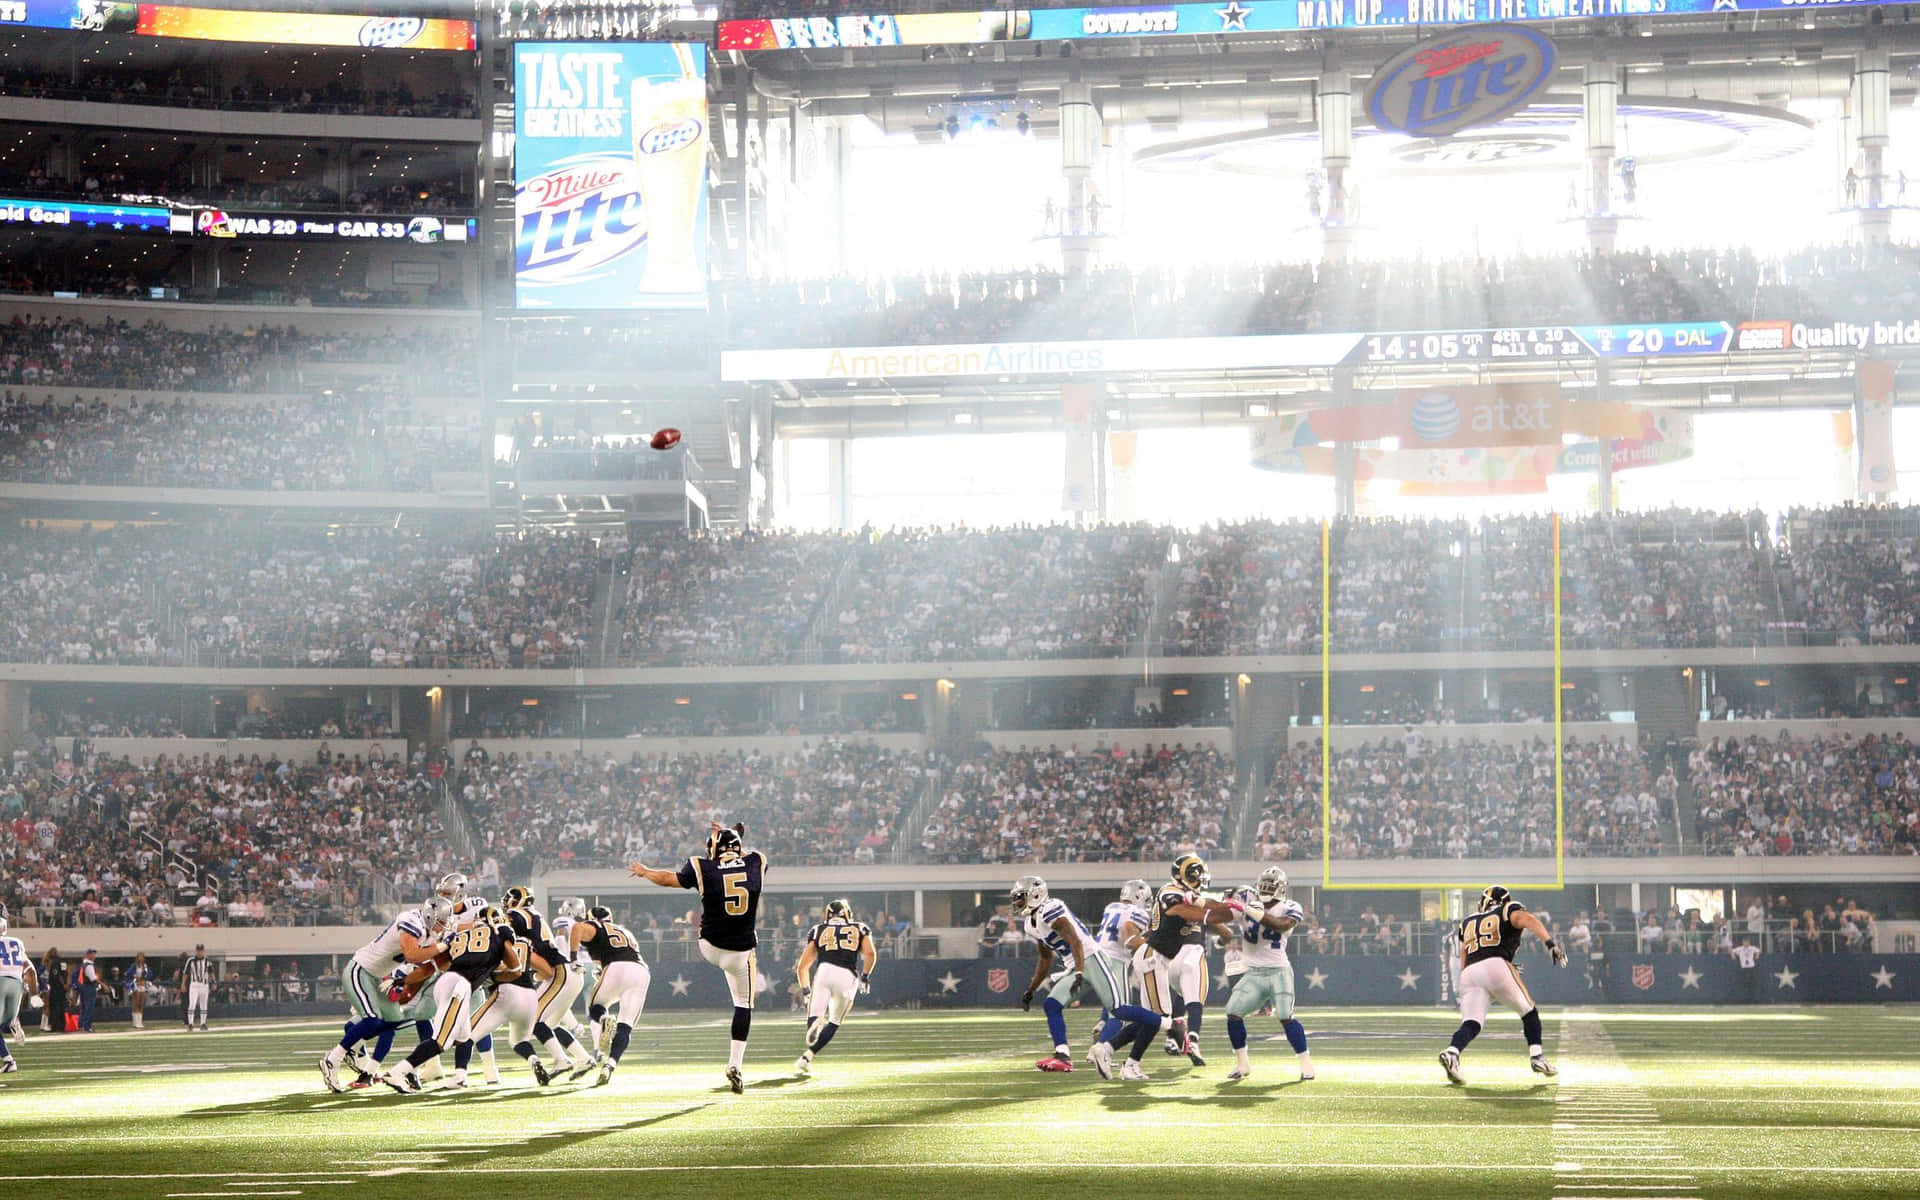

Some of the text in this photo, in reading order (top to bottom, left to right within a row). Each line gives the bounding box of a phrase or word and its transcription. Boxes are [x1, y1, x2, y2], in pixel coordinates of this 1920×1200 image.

[1083, 10, 1178, 34] COWBOYS
[1298, 0, 1344, 27] MAN
[1487, 0, 1528, 19] THE
[1416, 41, 1504, 74] Miller
[519, 52, 623, 108] TASTE
[1405, 53, 1527, 130] Lite
[528, 171, 623, 204] Miller
[29, 206, 70, 224] Goal
[229, 218, 405, 238] WAS 20 Final CAR 33
[516, 190, 643, 274] Lite
[1368, 334, 1459, 360] 14:05
[1493, 329, 1520, 343] 4th
[1544, 328, 1564, 342] 10
[1627, 328, 1713, 353] 20 DAL
[1792, 321, 1870, 349] Quality
[1468, 345, 1478, 357] 4
[1491, 342, 1528, 357] Ball
[1534, 342, 1554, 356] On
[1471, 397, 1552, 433] at&t
[723, 871, 749, 916] 5
[449, 926, 491, 960] 88
[818, 925, 859, 952] 43
[1463, 914, 1502, 954] 49
